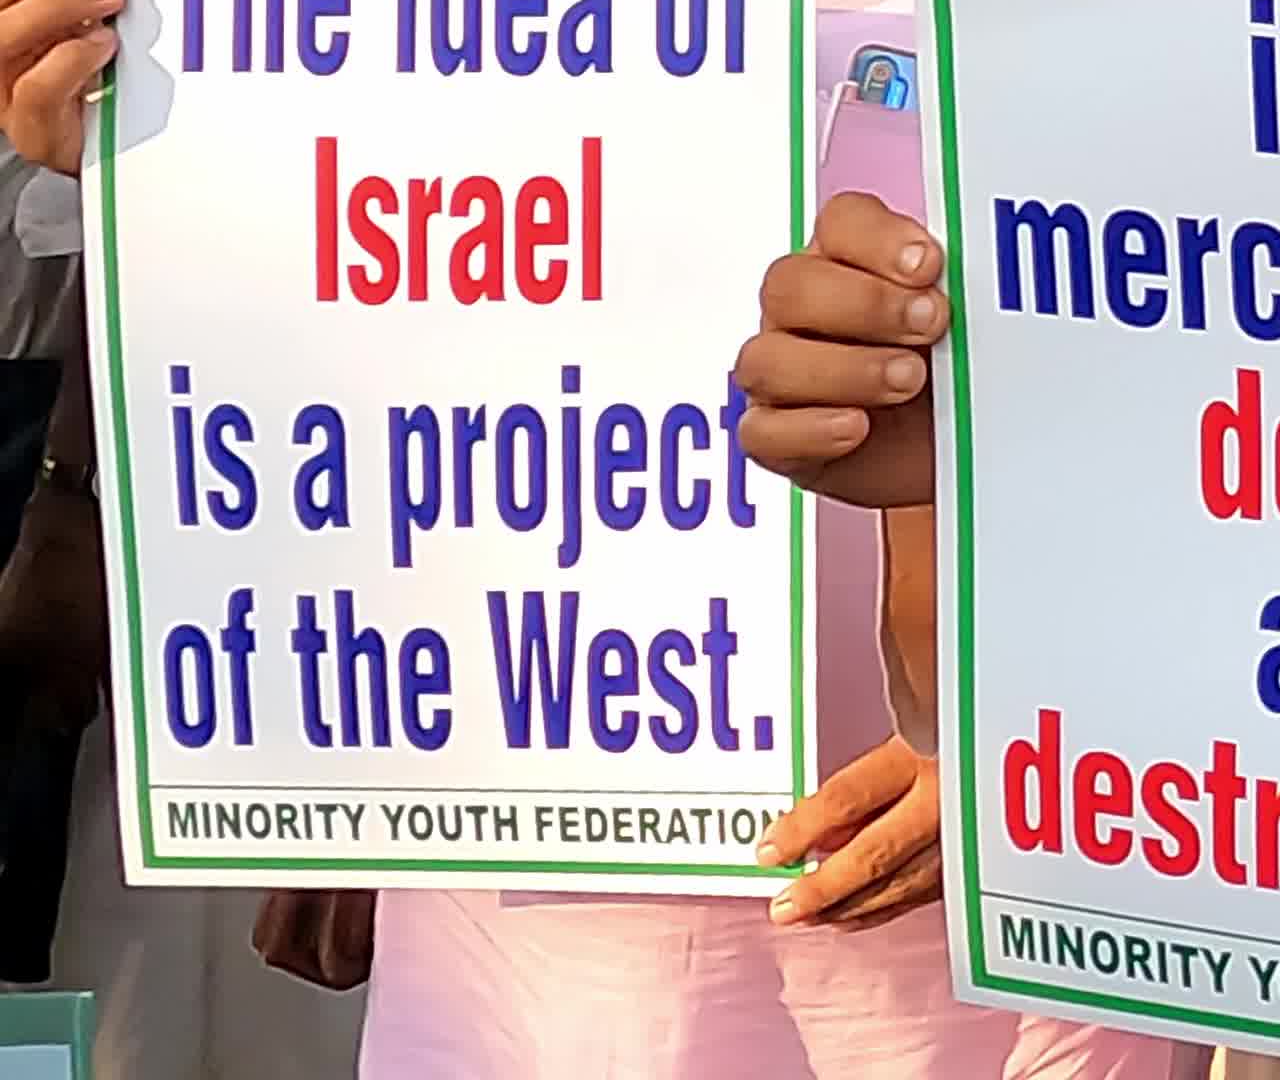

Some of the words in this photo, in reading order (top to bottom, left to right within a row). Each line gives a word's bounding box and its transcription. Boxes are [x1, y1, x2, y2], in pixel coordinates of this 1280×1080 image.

[315, 136, 603, 306] Israel
[169, 365, 258, 531] is
[292, 404, 351, 530] a
[389, 365, 756, 568] project
[164, 588, 257, 749] of
[291, 589, 453, 752] the
[487, 590, 774, 753] West.
[168, 801, 366, 842] MINORITY
[380, 803, 520, 843] YOUTH
[999, 913, 1231, 994] MINORITY
